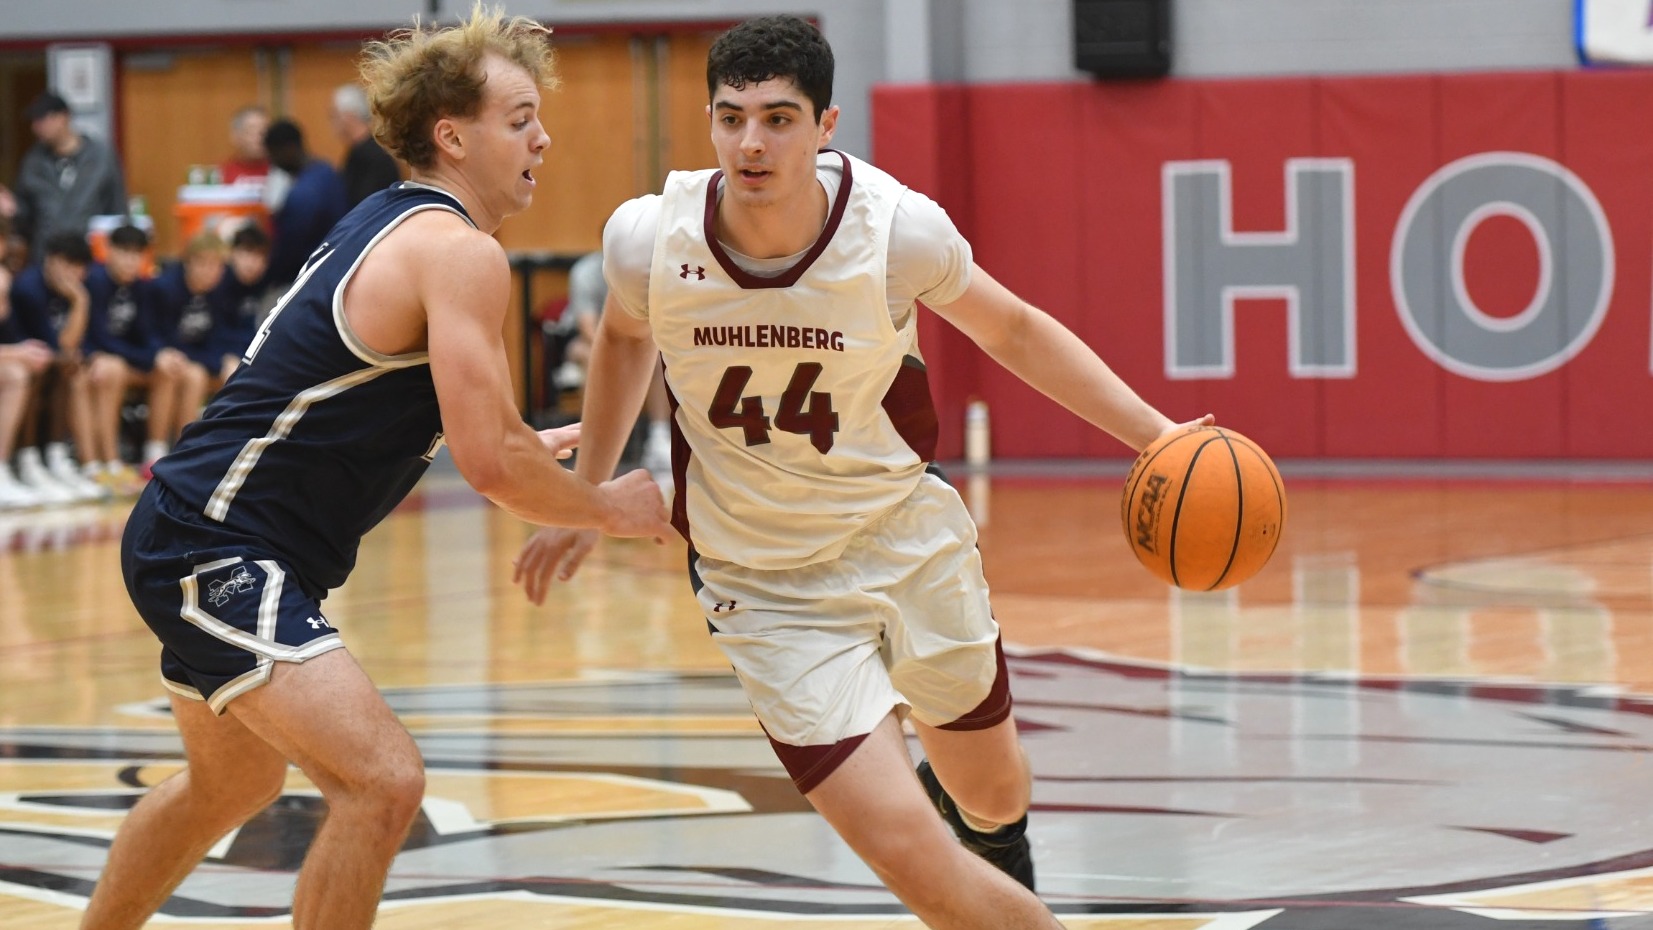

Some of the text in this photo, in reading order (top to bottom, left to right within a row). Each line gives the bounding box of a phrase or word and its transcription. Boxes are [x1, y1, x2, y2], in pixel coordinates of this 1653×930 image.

[1162, 151, 1653, 382] HO
[693, 324, 845, 352] MUHLENBERG
[707, 361, 840, 456] 44
[1136, 473, 1168, 556] NCAA
